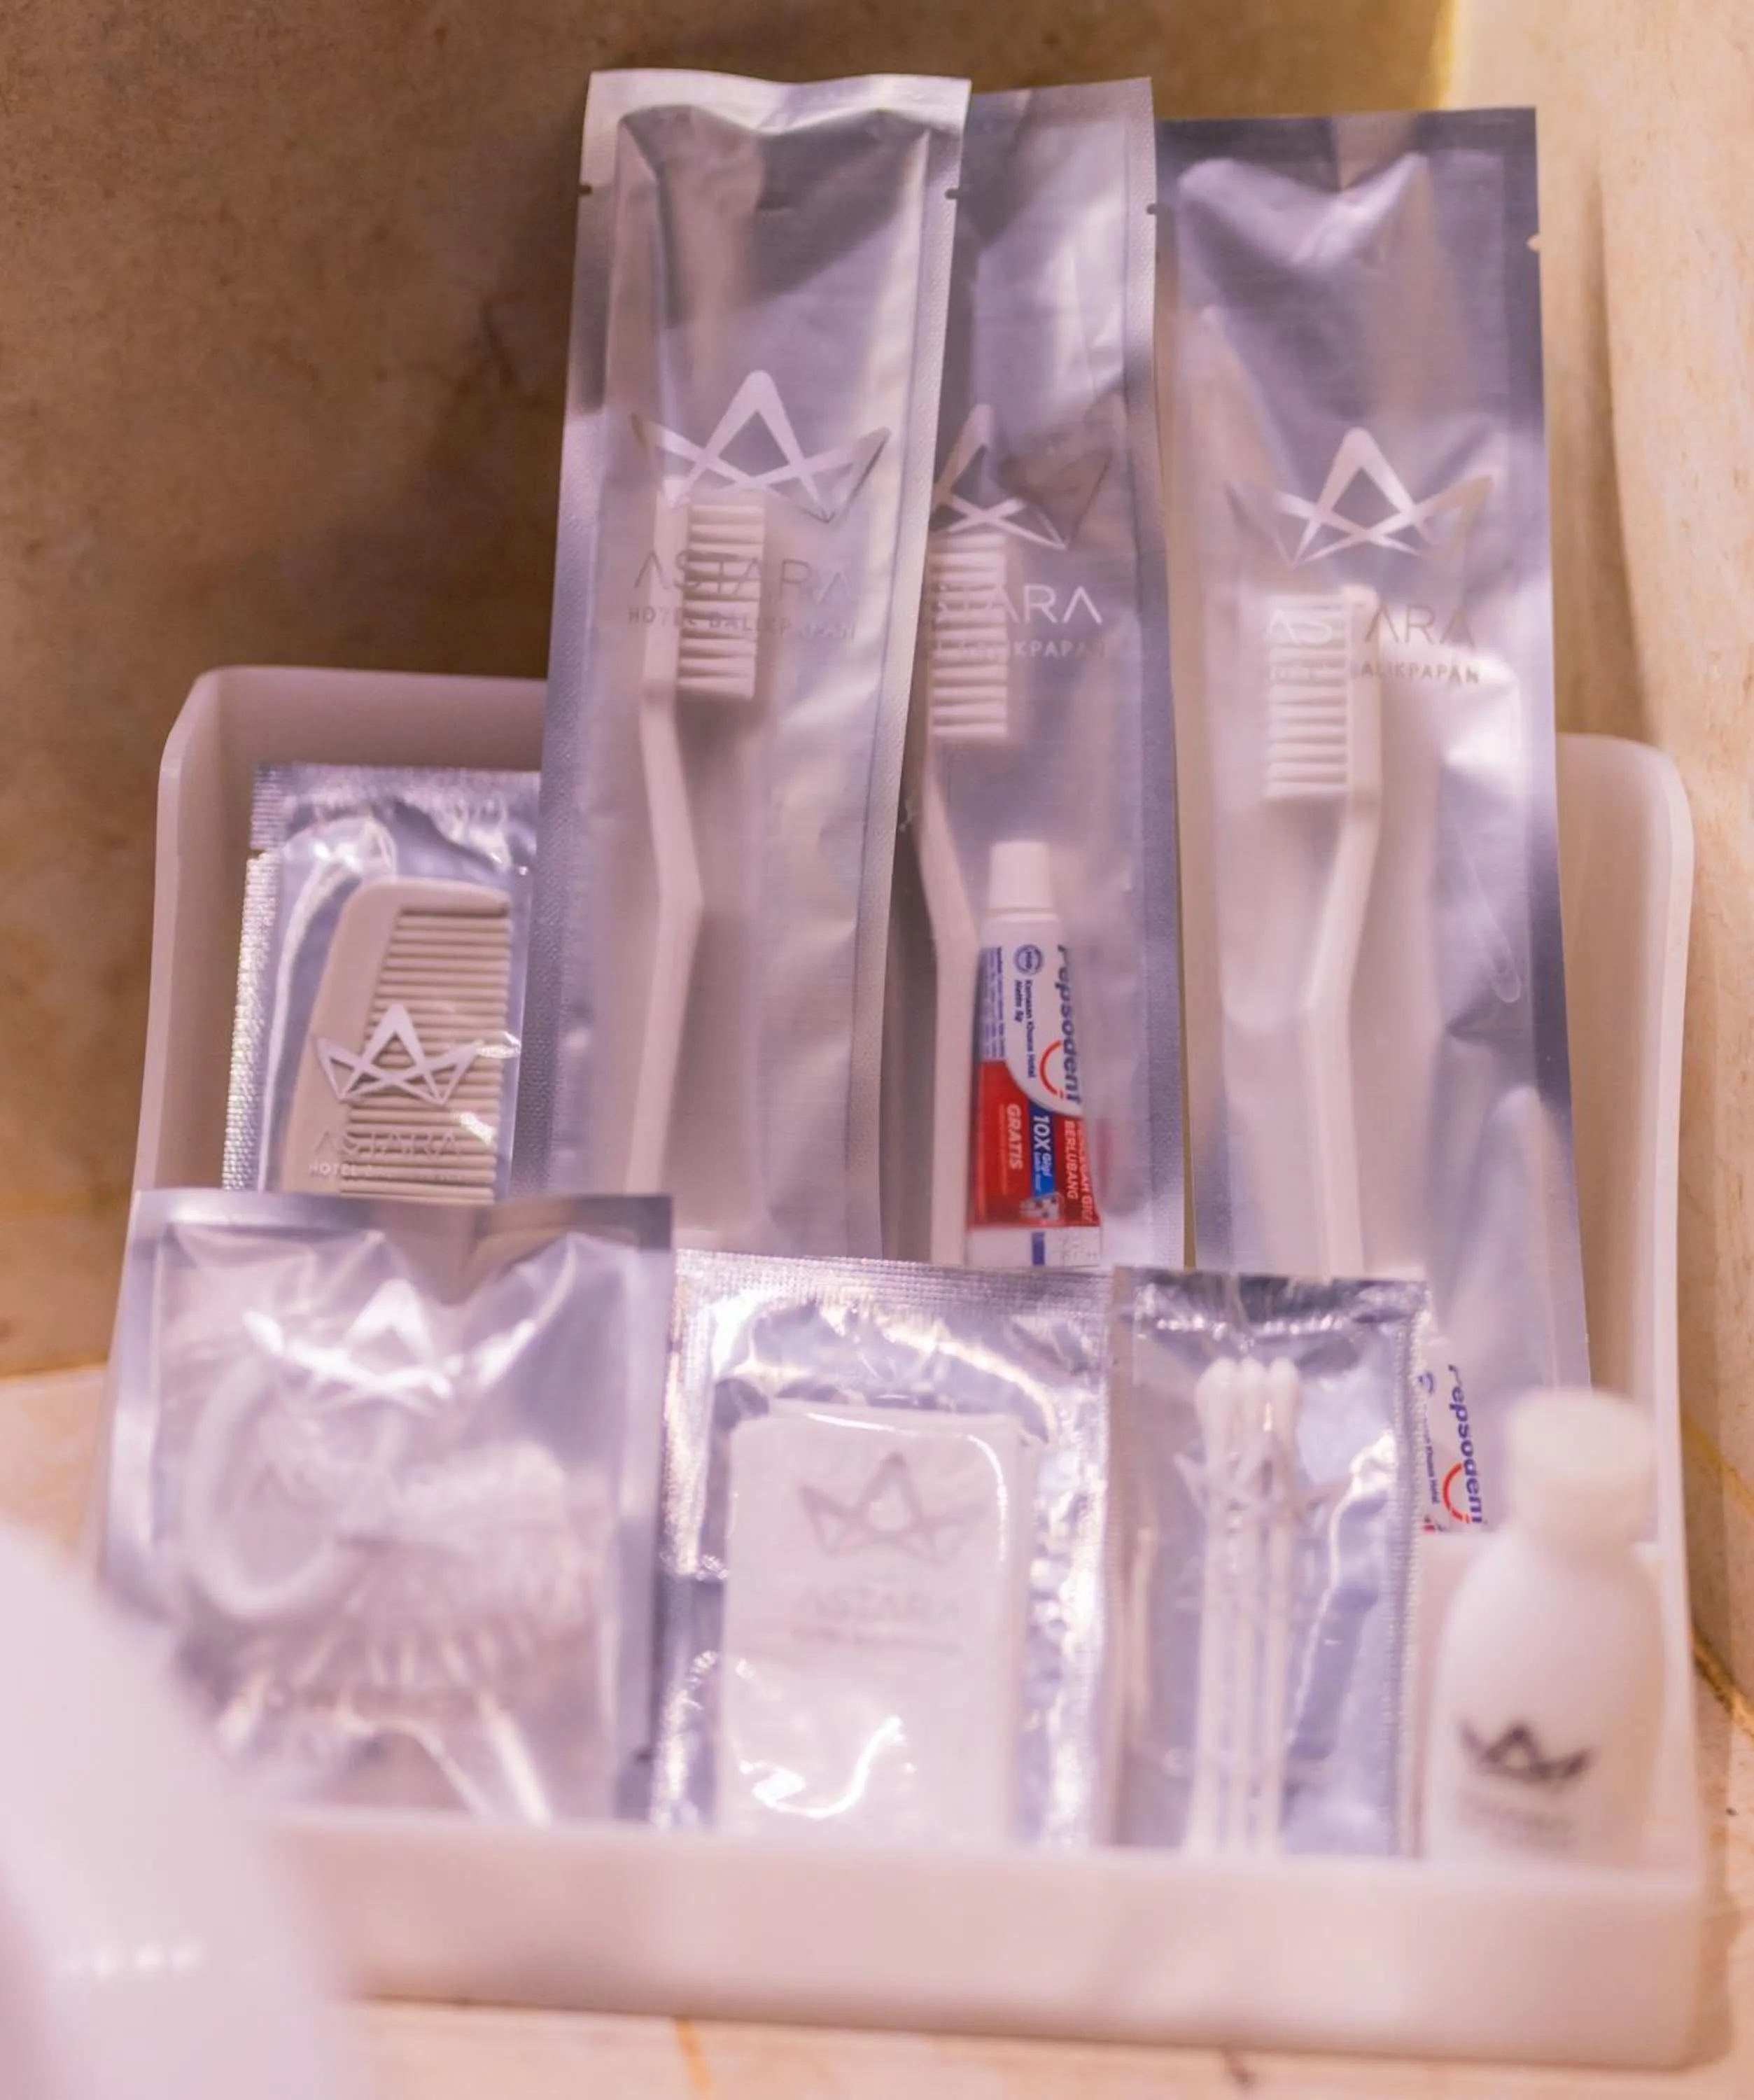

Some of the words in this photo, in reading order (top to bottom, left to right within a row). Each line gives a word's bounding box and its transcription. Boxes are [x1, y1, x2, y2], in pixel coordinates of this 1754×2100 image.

[634, 550, 853, 606] ASTARA
[932, 582, 1103, 625] STARA
[1266, 602, 1475, 645] ASARA
[1006, 1104, 1023, 1170] GRATIS
[1032, 1116, 1050, 1154] 10X
[309, 1161, 357, 1177] HOTEL
[1064, 1120, 1079, 1199] BERLUBANG
